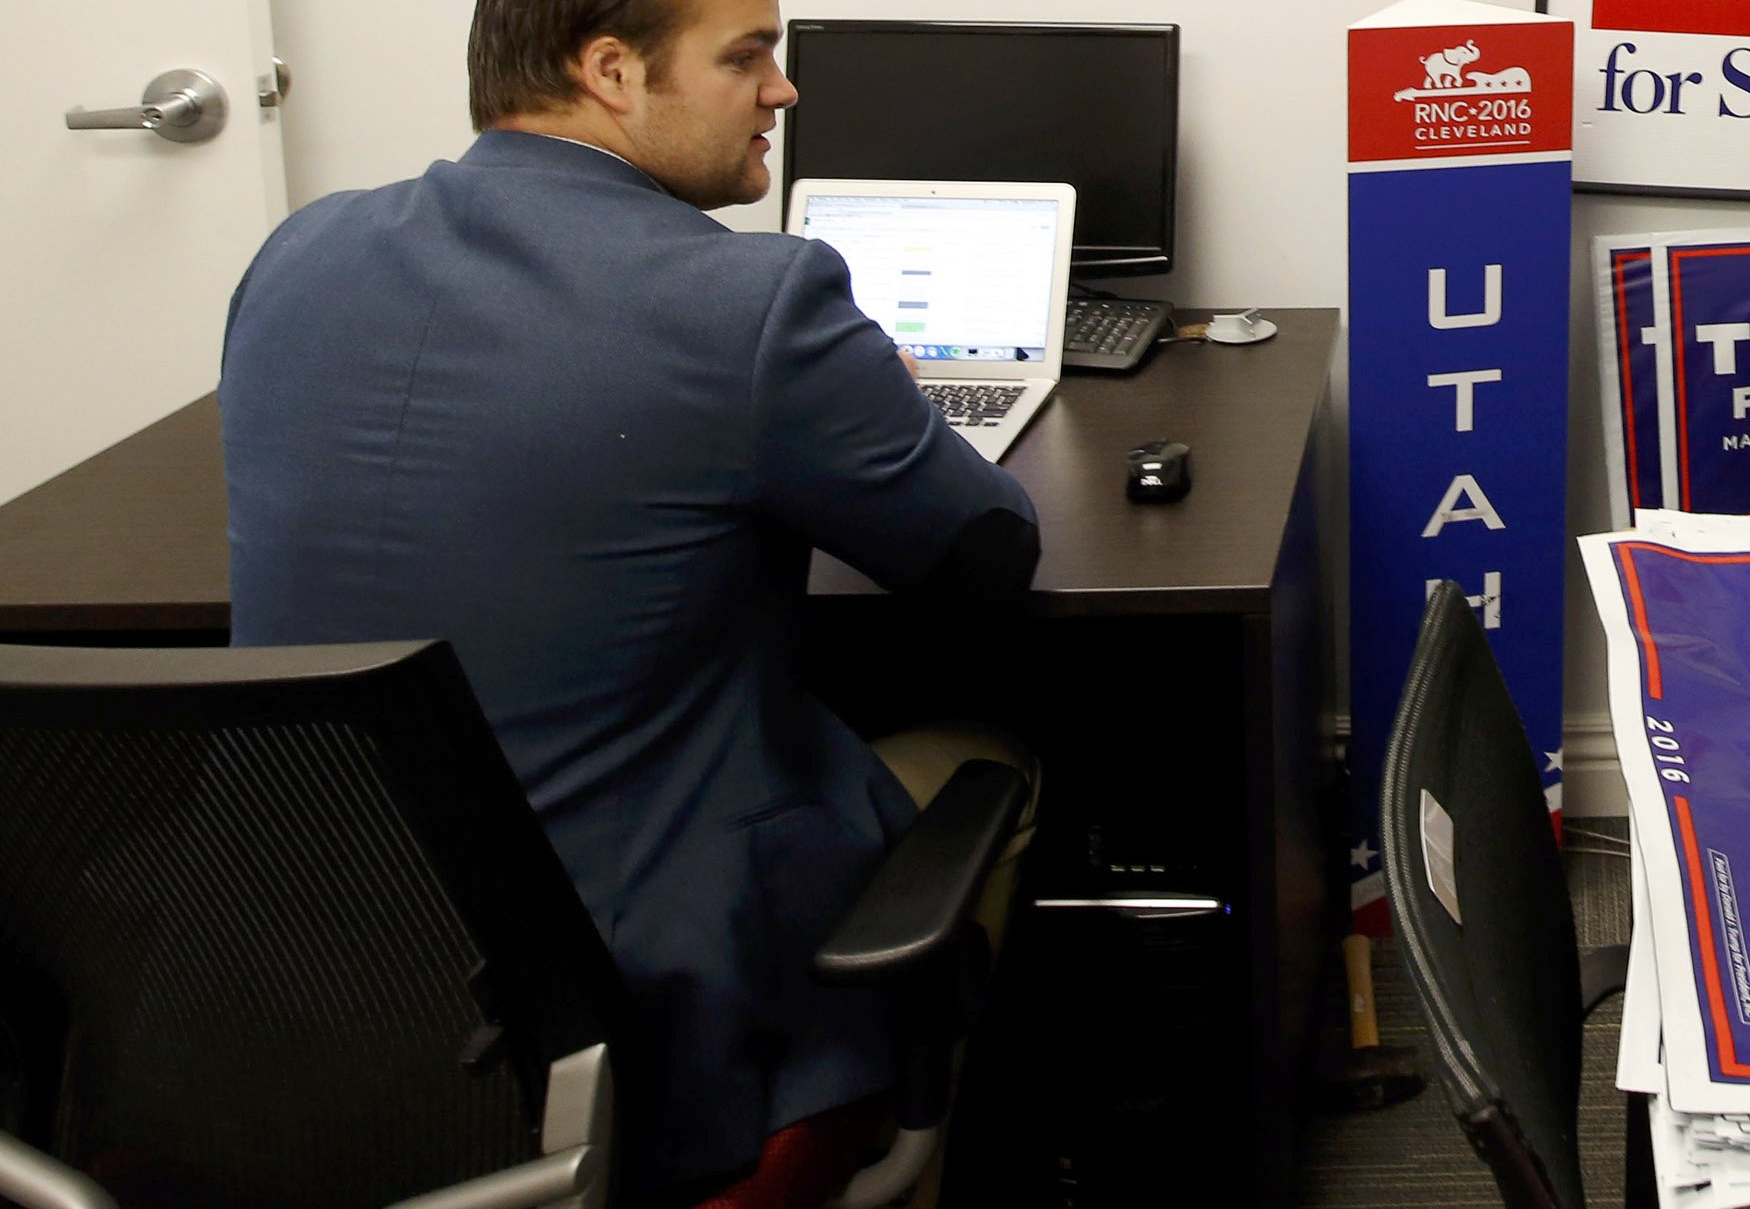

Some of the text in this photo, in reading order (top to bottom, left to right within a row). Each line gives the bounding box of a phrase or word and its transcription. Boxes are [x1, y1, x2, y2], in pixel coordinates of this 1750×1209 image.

[1414, 98, 1532, 124] RNC 2016
[1596, 42, 1703, 116] for
[1414, 122, 1532, 140] CLEVELAND
[1421, 263, 1507, 629] UTAH
[1646, 715, 1691, 785] 2016
